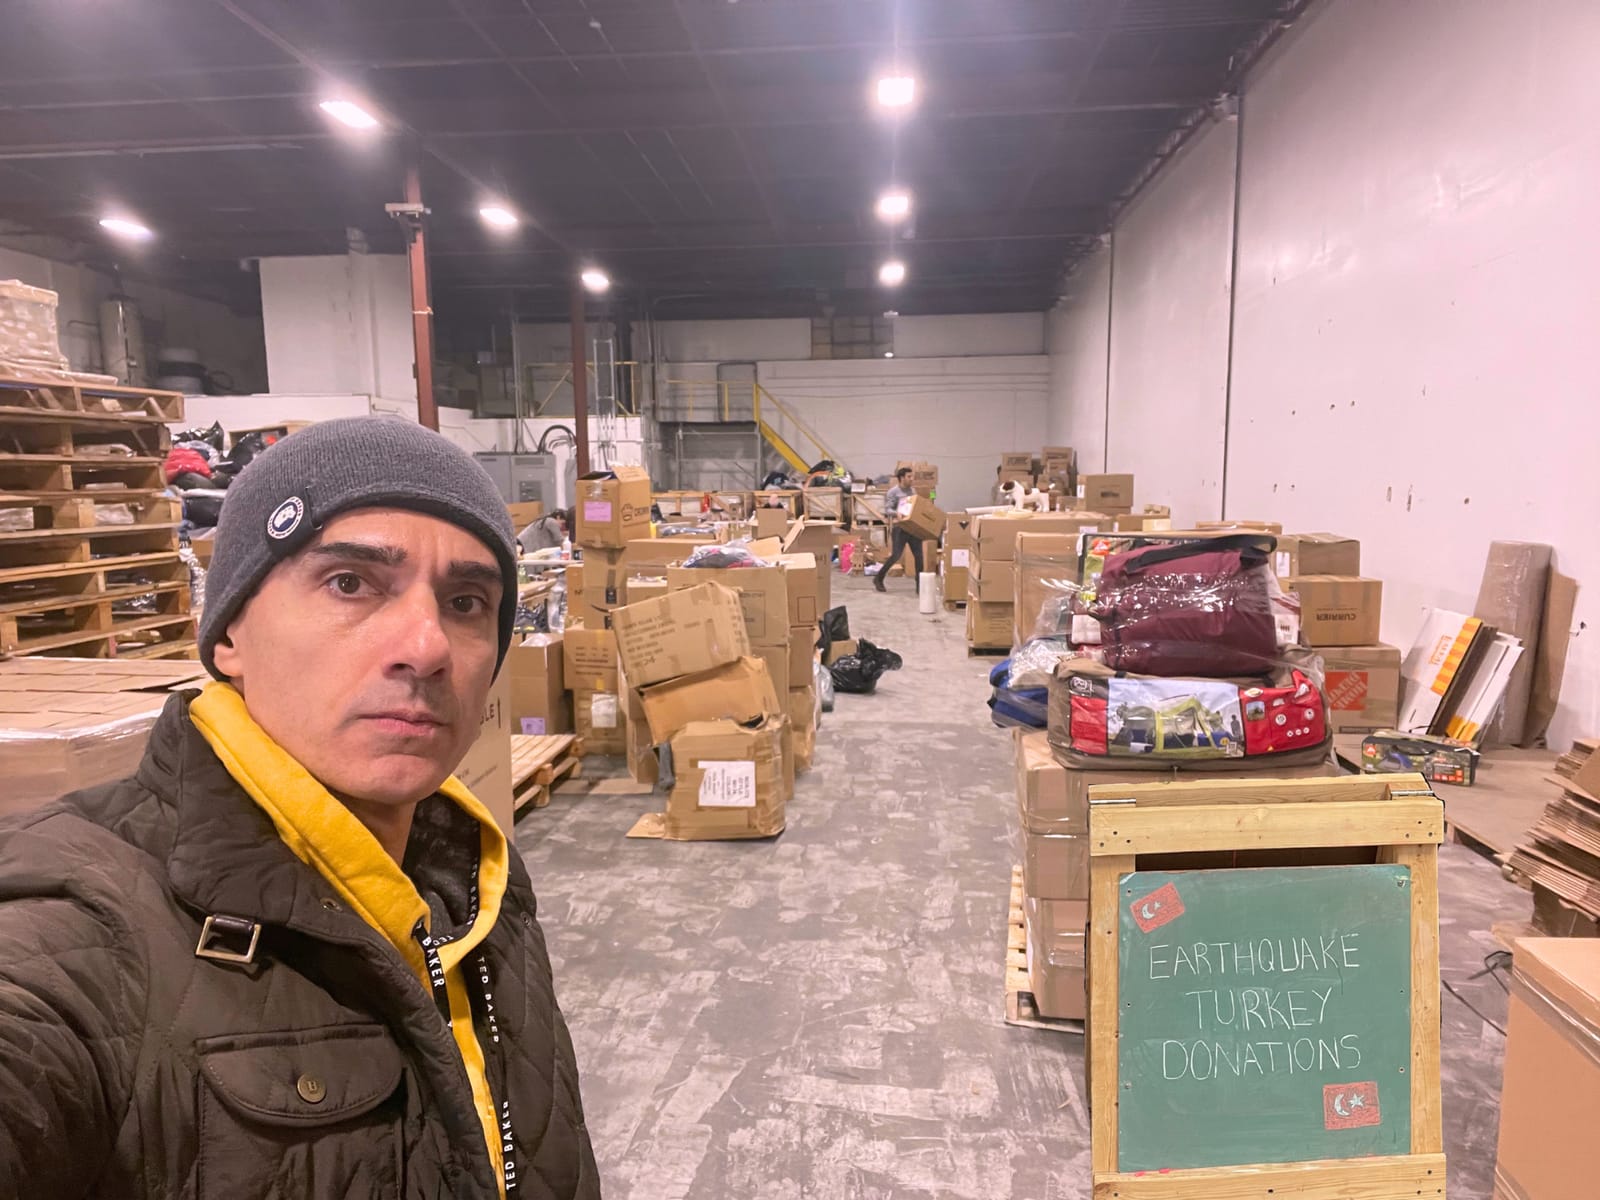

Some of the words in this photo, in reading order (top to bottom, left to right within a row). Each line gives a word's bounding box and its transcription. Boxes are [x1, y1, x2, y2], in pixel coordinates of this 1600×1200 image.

[421, 936, 445, 987] BAKER
[1150, 933, 1361, 979] EARTHQUAKE
[478, 956, 489, 984] TED
[484, 993, 499, 1043] BAKER
[1185, 986, 1333, 1031] TURKEY
[1162, 1034, 1361, 1081] DONATIONS
[502, 1101, 514, 1153] BAKER
[504, 1161, 517, 1191] TED
